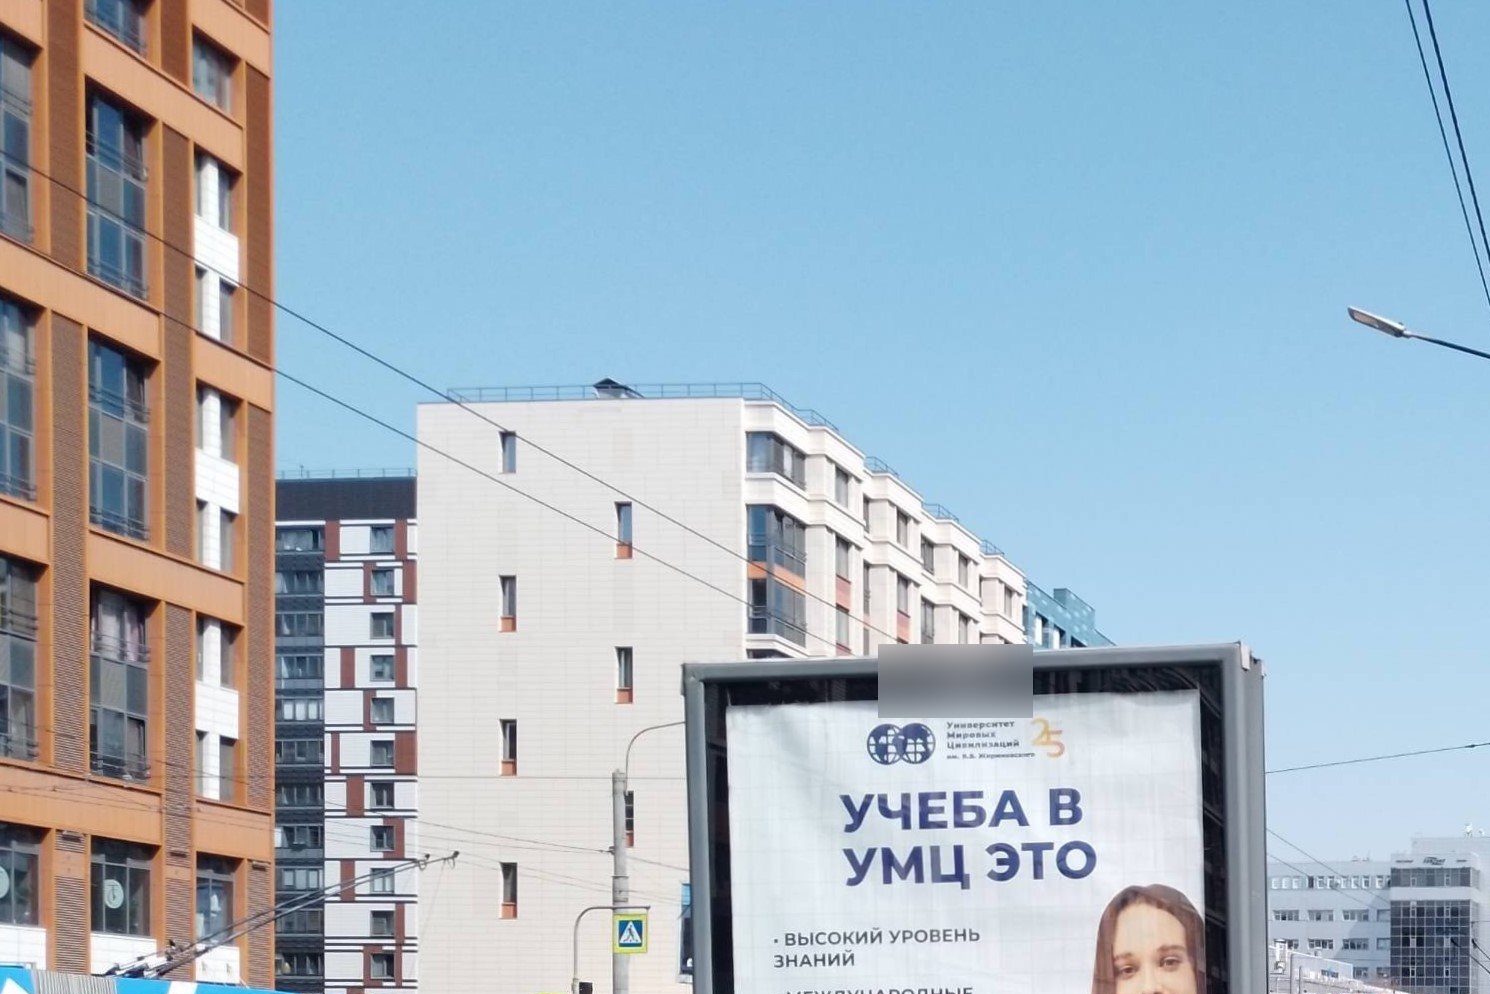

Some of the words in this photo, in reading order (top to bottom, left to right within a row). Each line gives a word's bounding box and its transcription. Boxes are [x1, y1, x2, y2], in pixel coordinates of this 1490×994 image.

[947, 721, 1015, 729] Университет
[947, 740, 1019, 749] Цивилизаций
[840, 790, 1029, 833] УЧЕБА
[1049, 788, 1082, 825] В
[843, 845, 970, 890] УМЦ
[986, 841, 1096, 881] ЭТО
[785, 928, 882, 946] ВЫСОКИЙ
[889, 929, 980, 944] УРОВЕНЬ
[774, 950, 854, 968] ЗНАНИЙ
